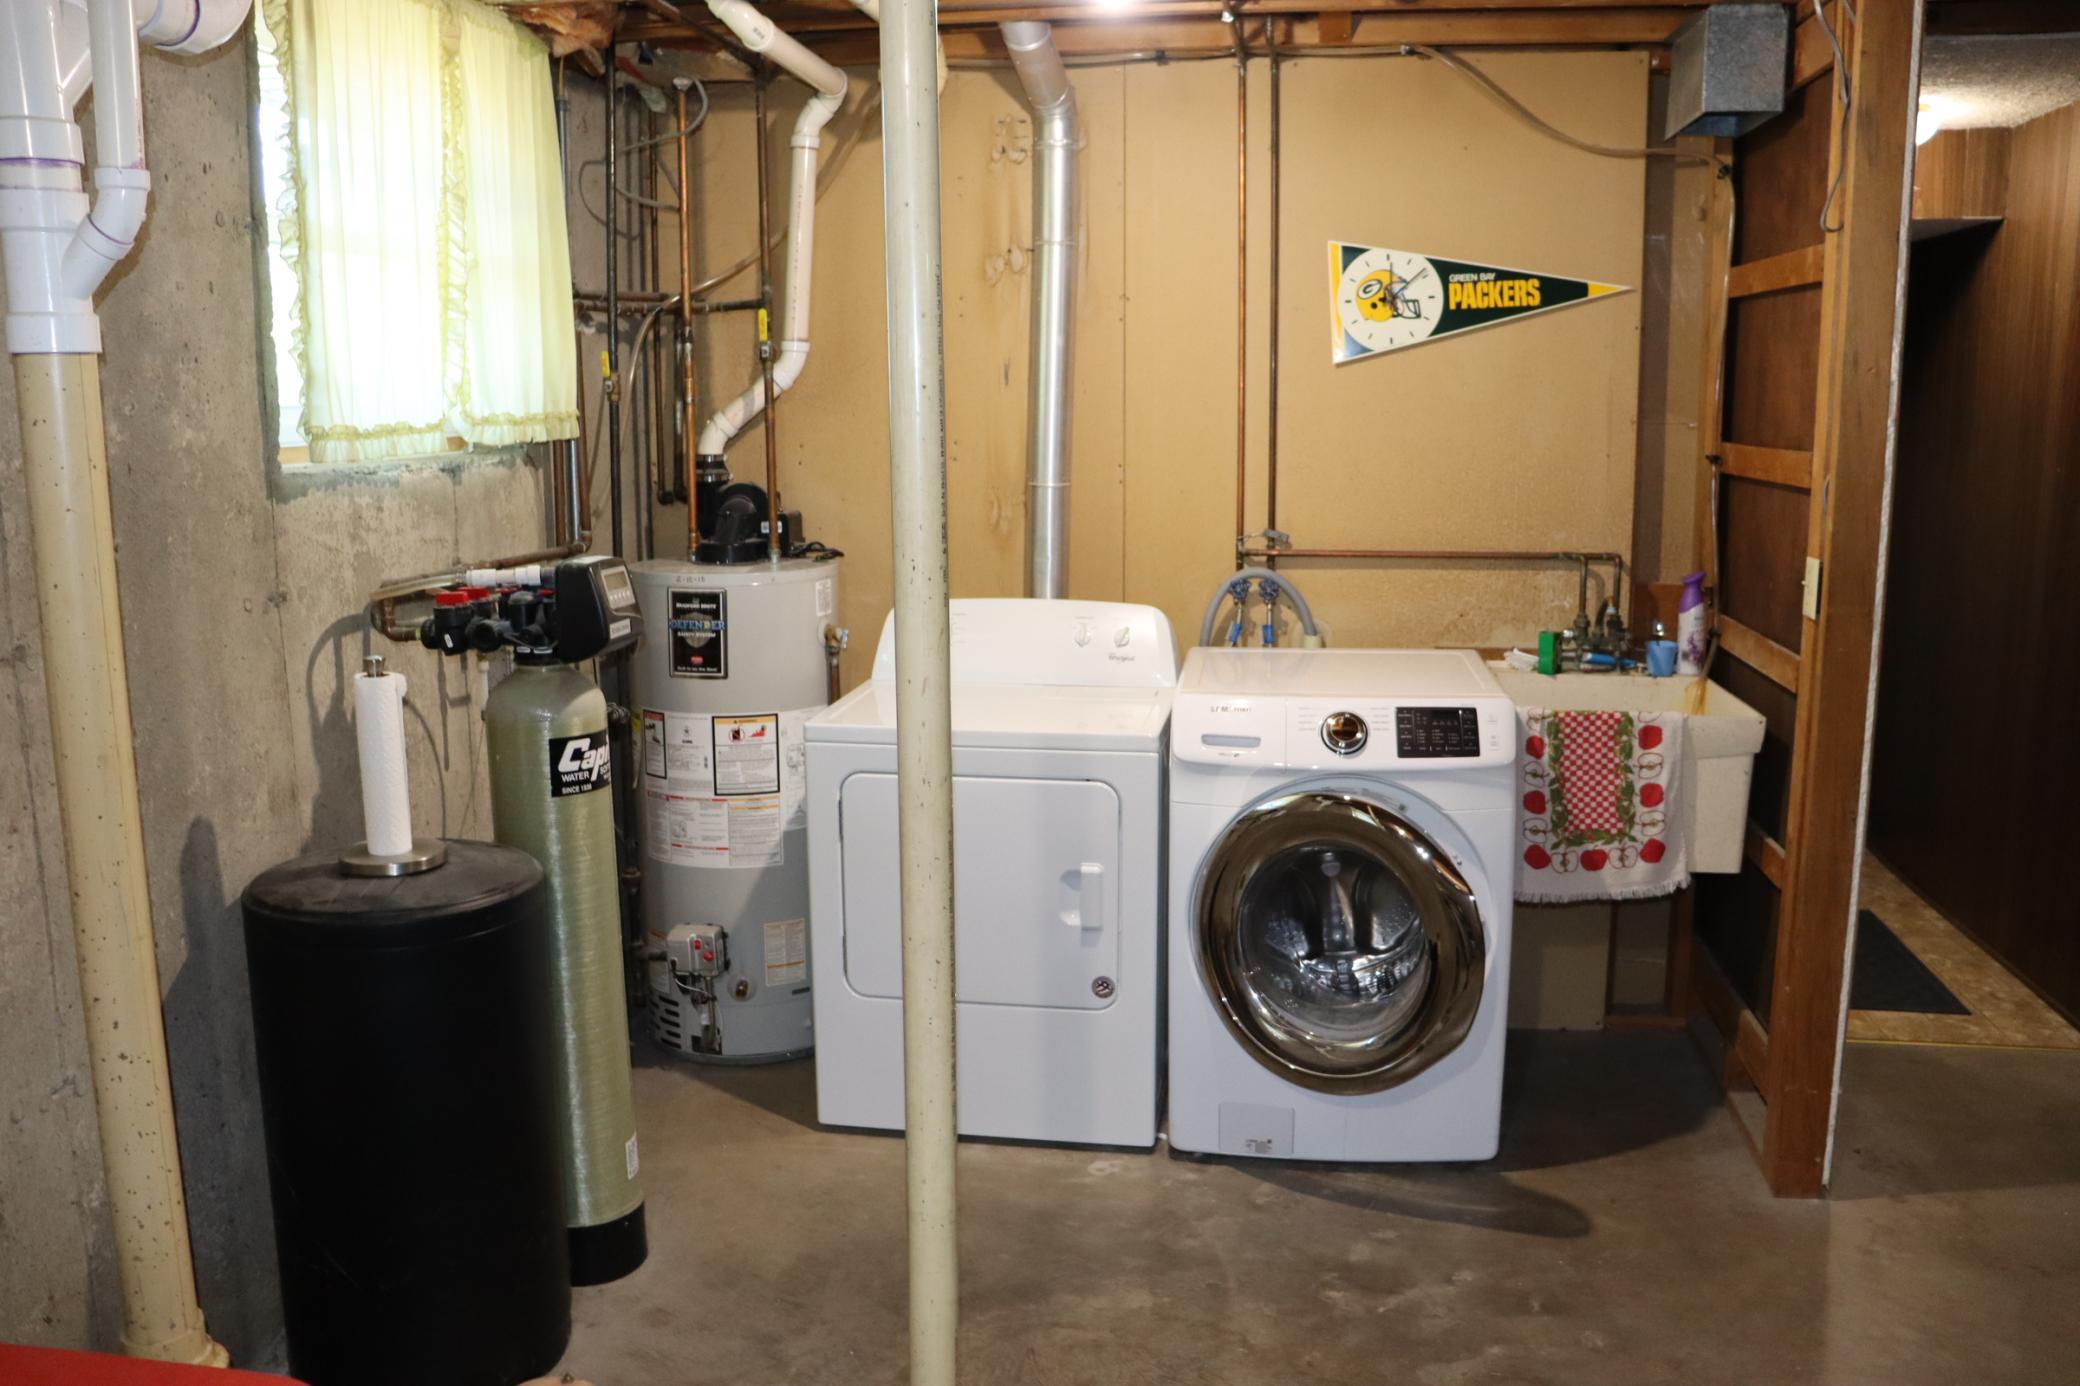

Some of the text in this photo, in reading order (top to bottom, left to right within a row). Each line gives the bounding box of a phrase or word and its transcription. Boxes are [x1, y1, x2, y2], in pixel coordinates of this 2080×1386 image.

[1448, 272, 1496, 282] GREEN BAY
[1448, 278, 1541, 310] PACKERS
[670, 620, 725, 631] DEFENDER
[561, 771, 589, 782] WATER
